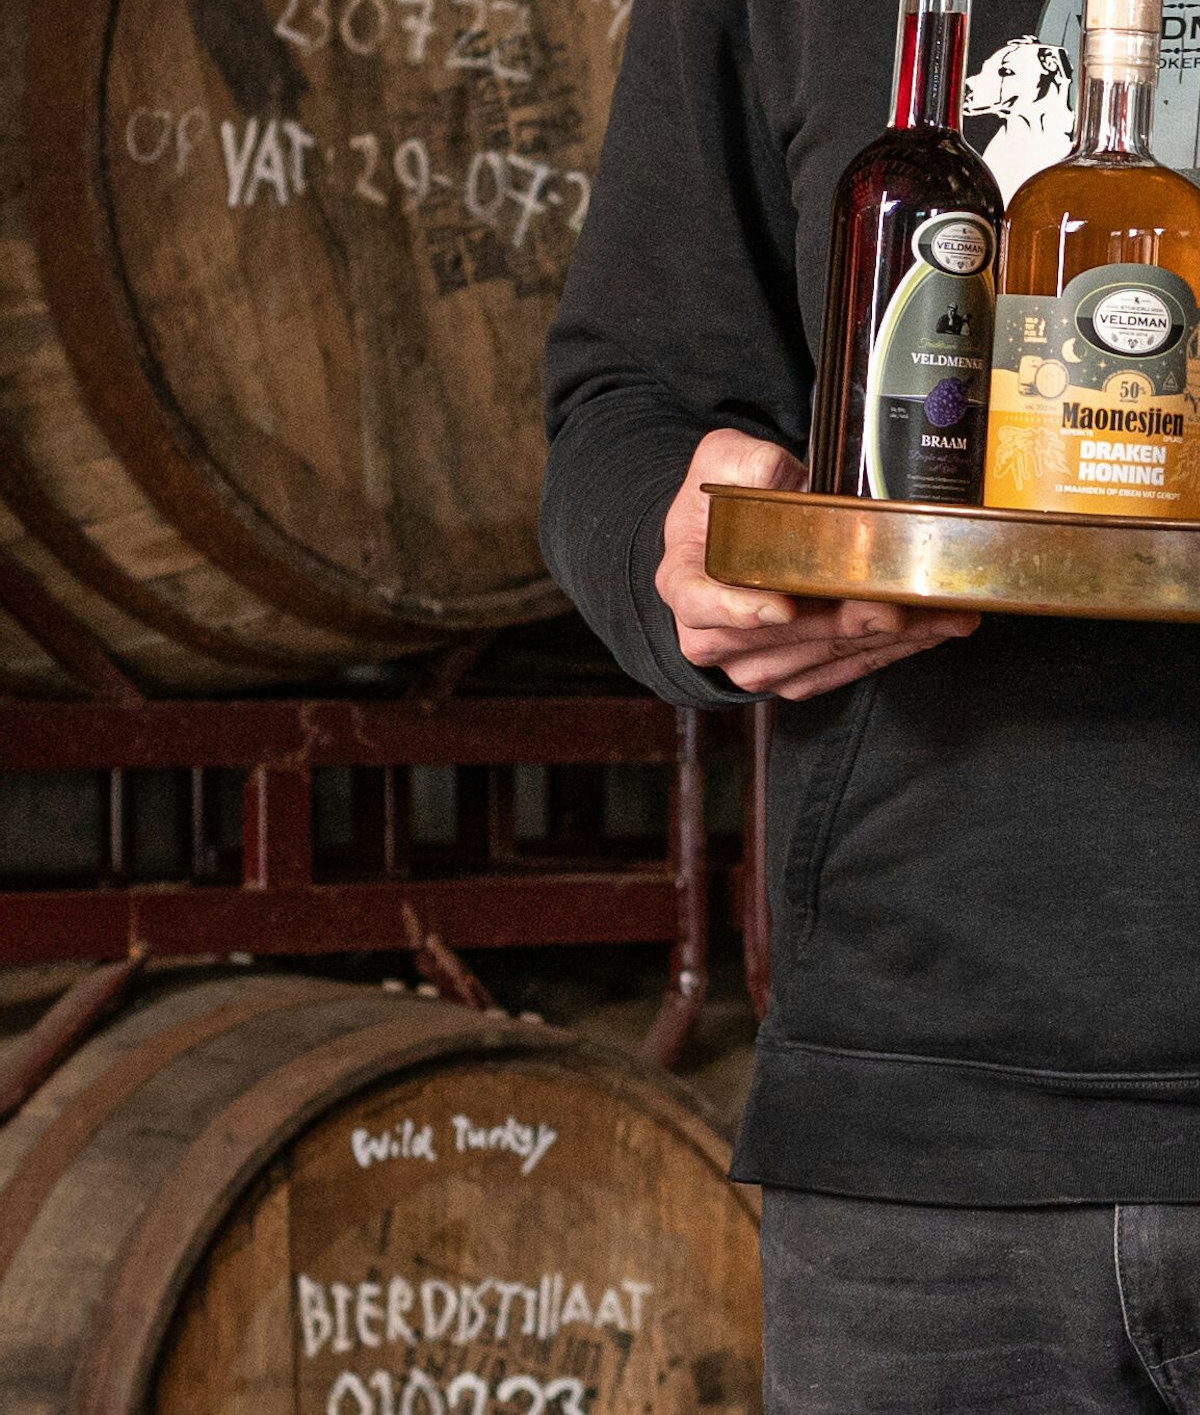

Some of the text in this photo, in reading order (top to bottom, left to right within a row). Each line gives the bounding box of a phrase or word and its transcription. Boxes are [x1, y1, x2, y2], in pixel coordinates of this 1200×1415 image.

[937, 241, 985, 254] VELDMAN
[1100, 314, 1167, 329] VELDMAN
[1062, 402, 1184, 438] Maonesjien
[921, 434, 967, 450] BRAAM
[1079, 441, 1166, 465] DRAKEN
[1078, 463, 1165, 486] HONING
